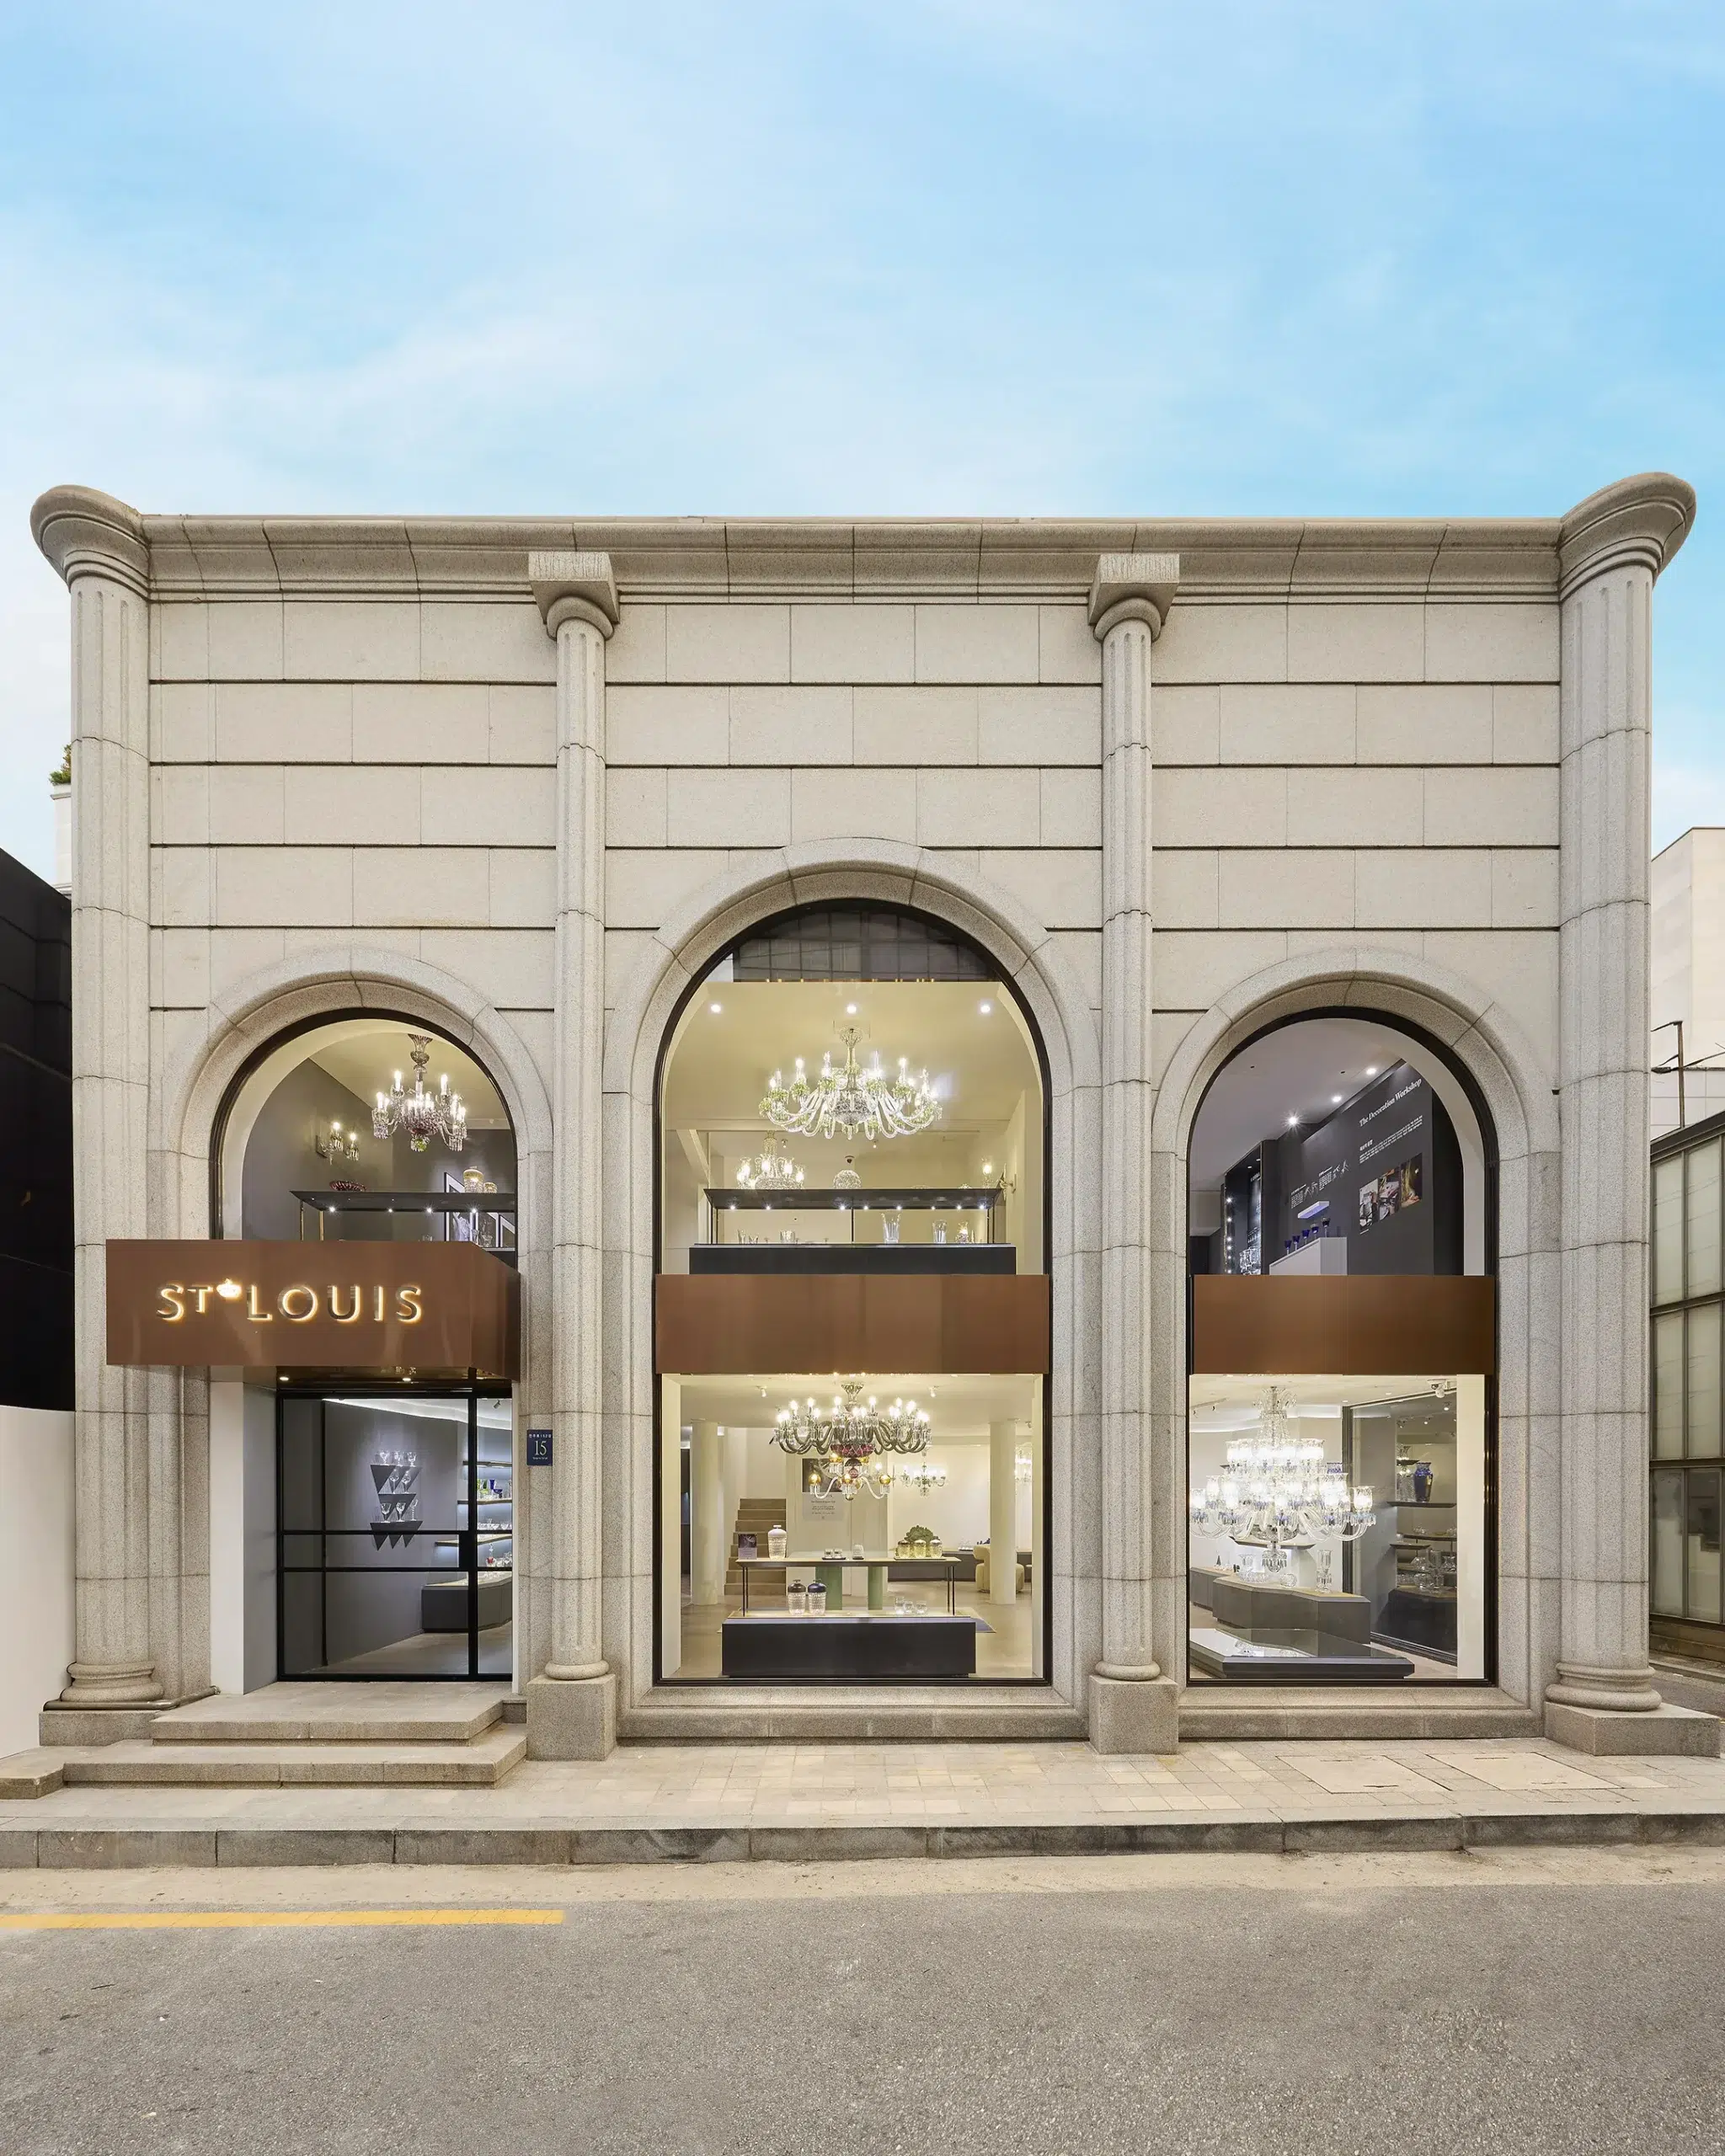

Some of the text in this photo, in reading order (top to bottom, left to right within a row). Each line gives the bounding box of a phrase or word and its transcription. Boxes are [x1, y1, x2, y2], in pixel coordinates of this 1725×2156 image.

[1359, 1079, 1422, 1127] The Decoration Workshop
[246, 1283, 423, 1322] LOUIS
[535, 1440, 547, 1455] 15
